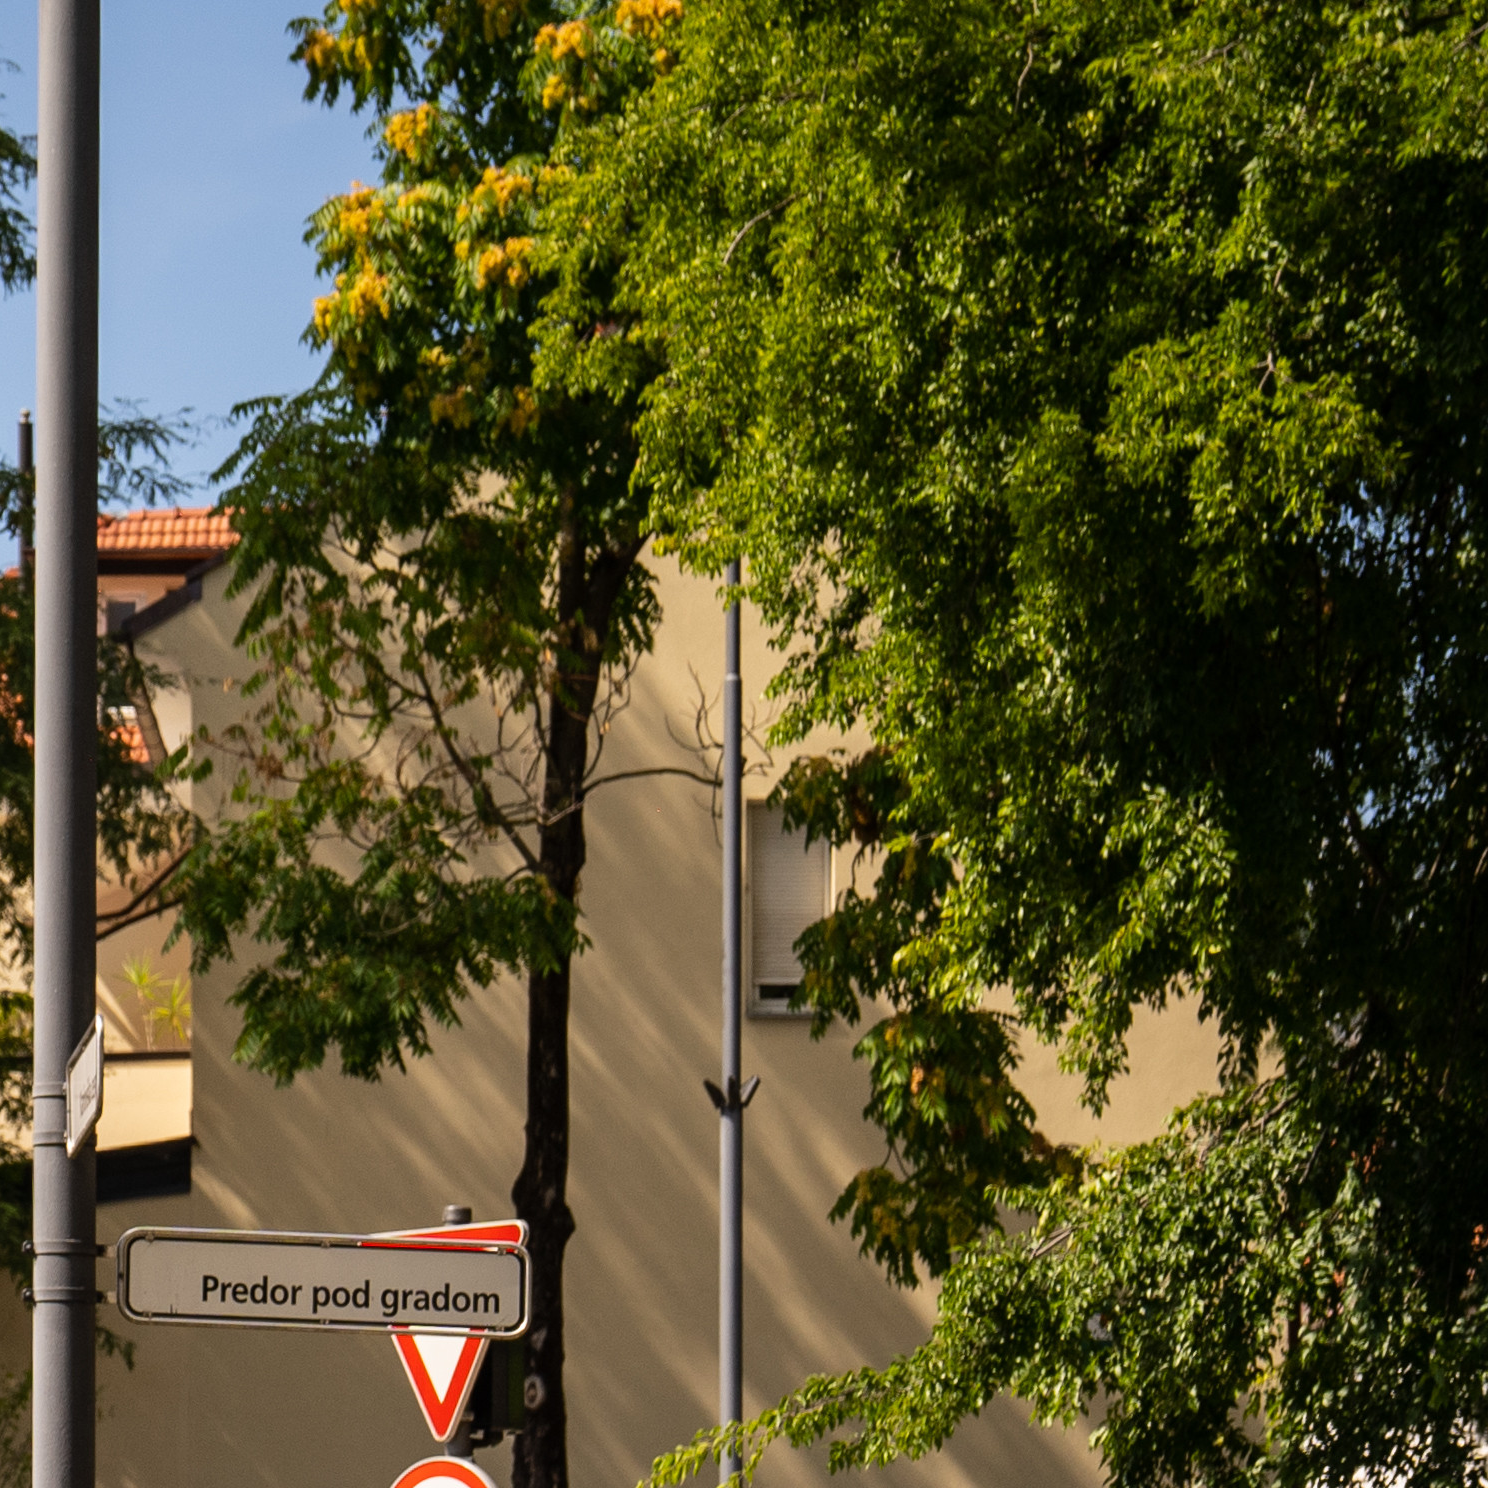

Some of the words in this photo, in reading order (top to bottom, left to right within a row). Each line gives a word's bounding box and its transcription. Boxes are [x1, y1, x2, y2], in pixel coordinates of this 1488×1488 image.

[201, 1275, 302, 1306] Predor
[312, 1279, 371, 1314] pod
[380, 1283, 500, 1317] gradom
